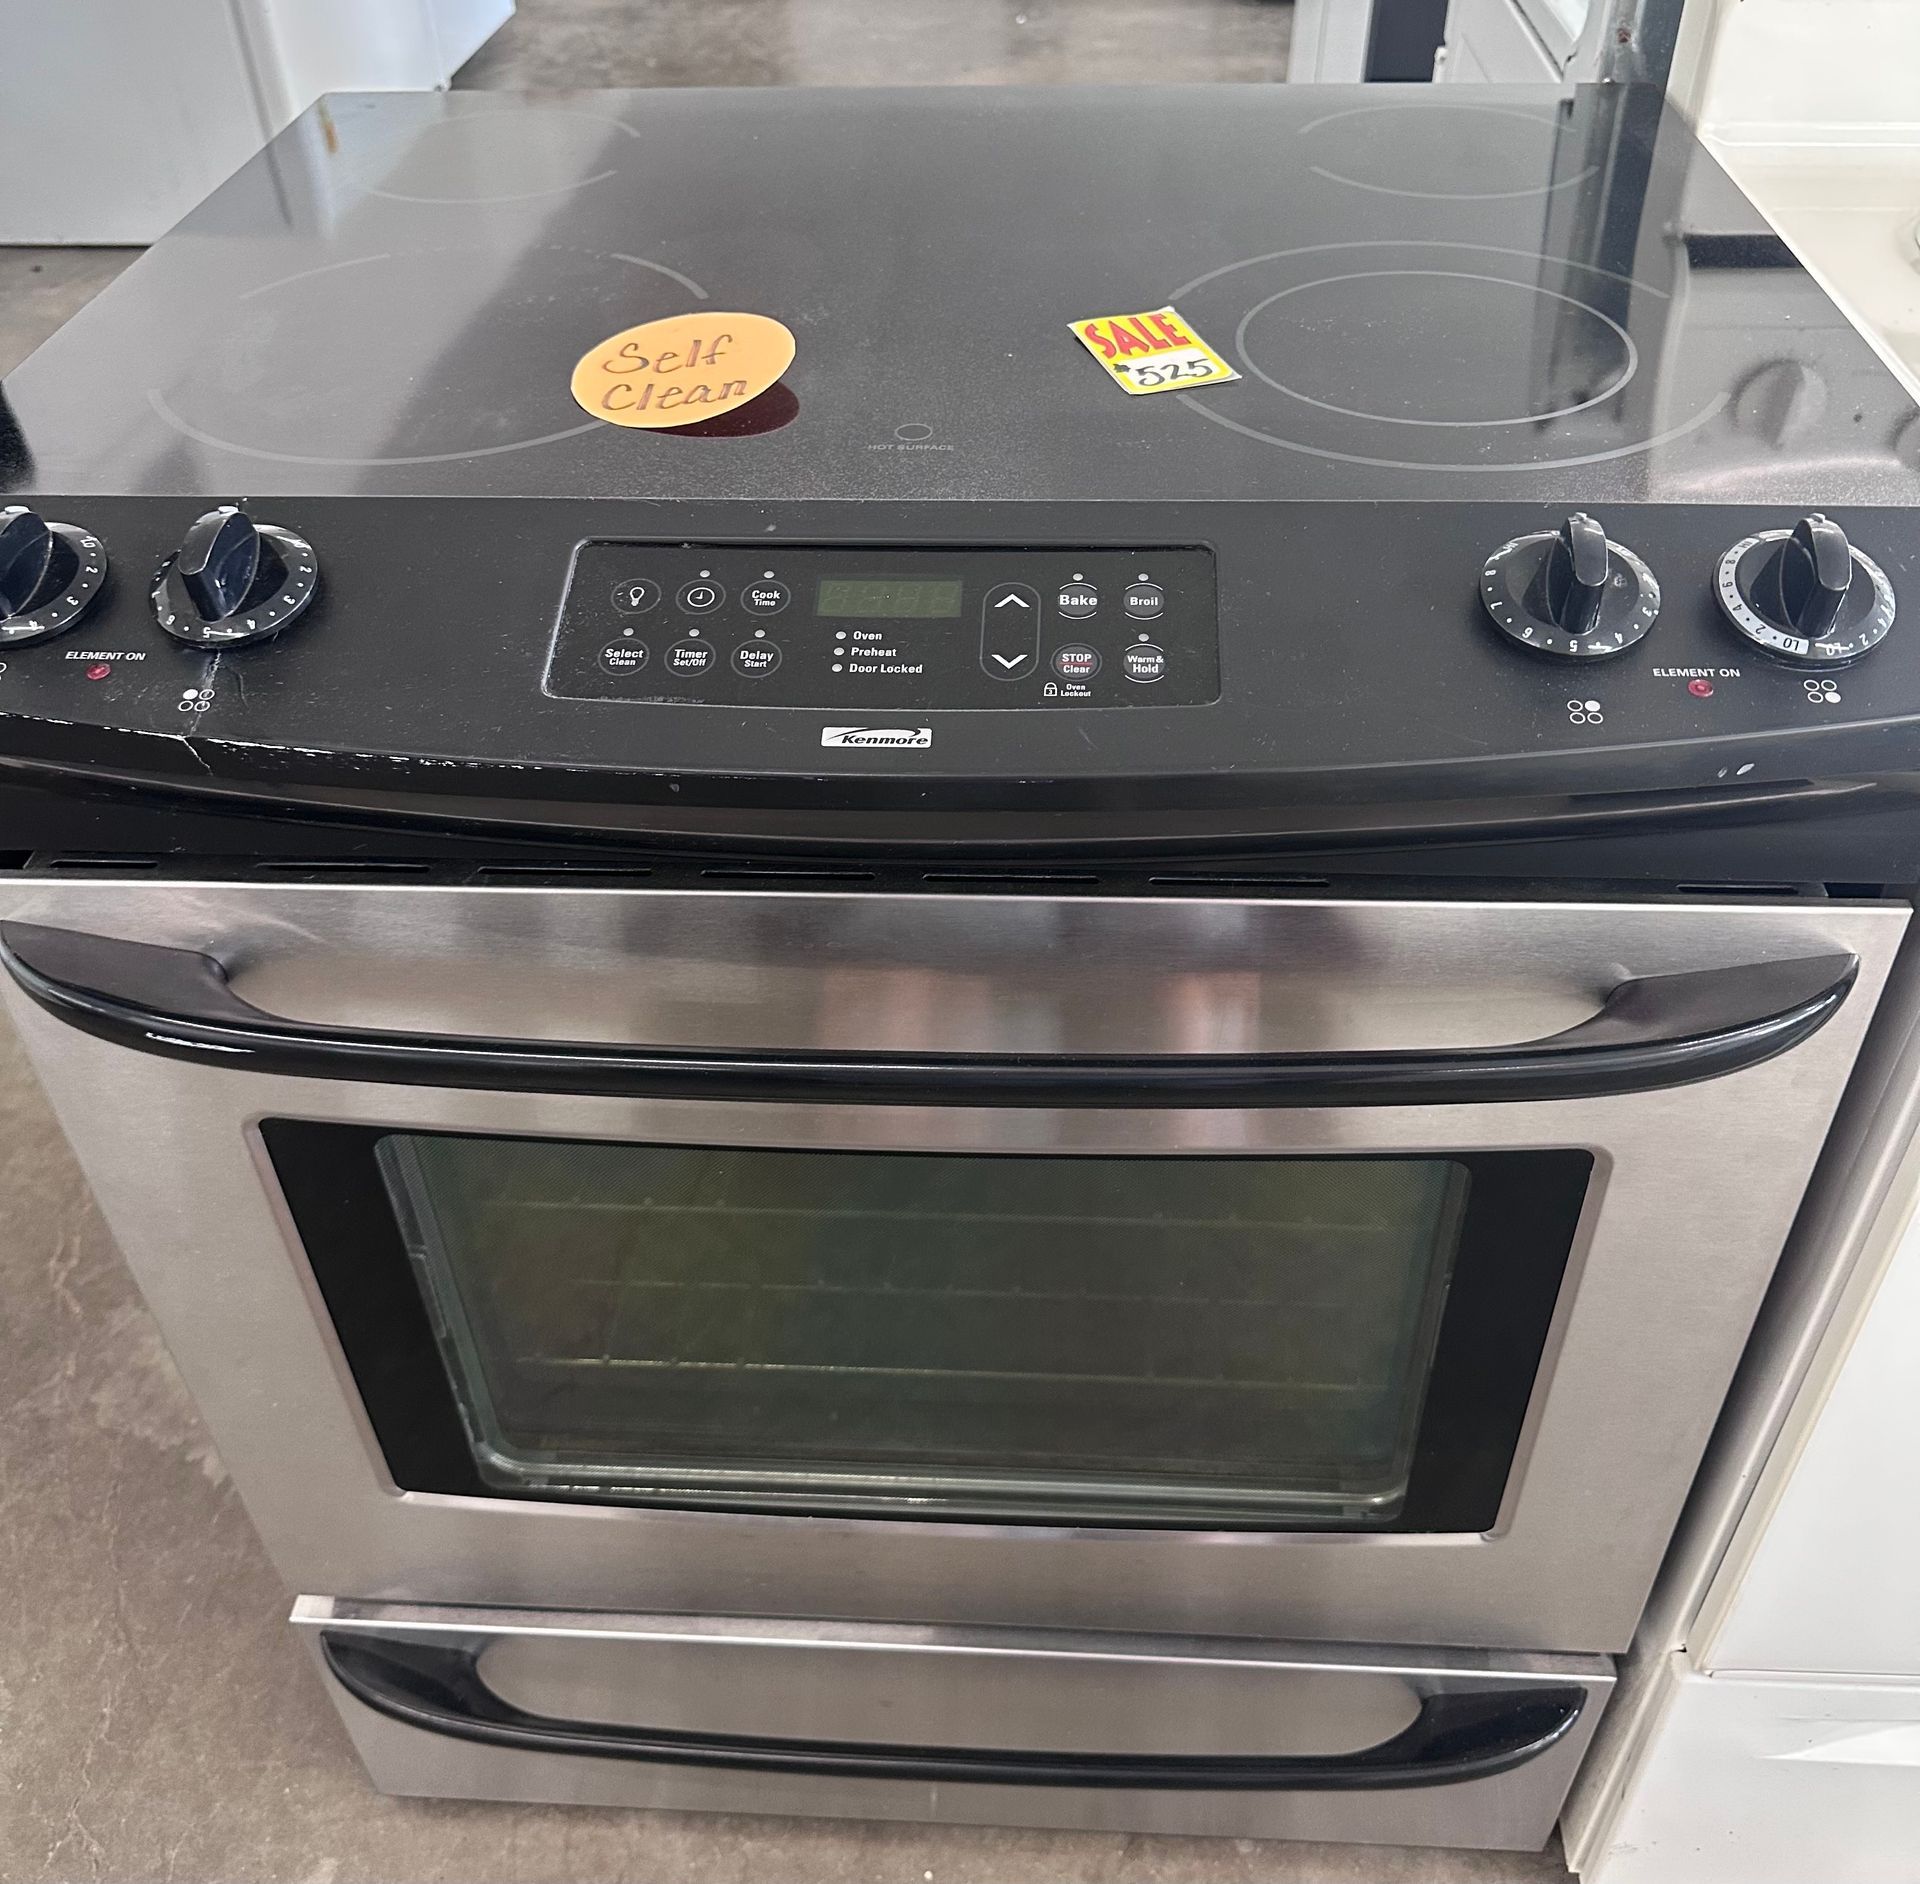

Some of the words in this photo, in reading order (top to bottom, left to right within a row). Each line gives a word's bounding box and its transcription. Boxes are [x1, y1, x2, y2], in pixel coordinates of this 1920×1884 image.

[1084, 313, 1192, 359] SALE
[602, 334, 733, 374] Self
[601, 380, 747, 411] Clean
[752, 590, 781, 600] Cook
[1059, 594, 1098, 606] Bake
[754, 599, 776, 607] Time
[1130, 596, 1158, 606] Broil
[853, 631, 882, 640] Oven
[65, 651, 123, 661] ELEMENT
[125, 651, 146, 661] ON
[605, 649, 644, 659] Select
[674, 649, 708, 659] Timer
[740, 650, 774, 661] Delay
[851, 647, 897, 657] Preheat
[609, 658, 636, 666] Clean
[673, 658, 706, 667] Set/Off
[1062, 653, 1092, 662] STOP
[744, 660, 767, 668] Start
[849, 663, 878, 673] Door
[880, 663, 923, 674] Locked
[1063, 664, 1090, 674] Clear
[1133, 664, 1159, 673] Hold
[1652, 668, 1715, 677] ELEMENT
[1719, 668, 1741, 678] ON
[1066, 683, 1086, 691] Oven
[841, 735, 929, 745] Kenmore
